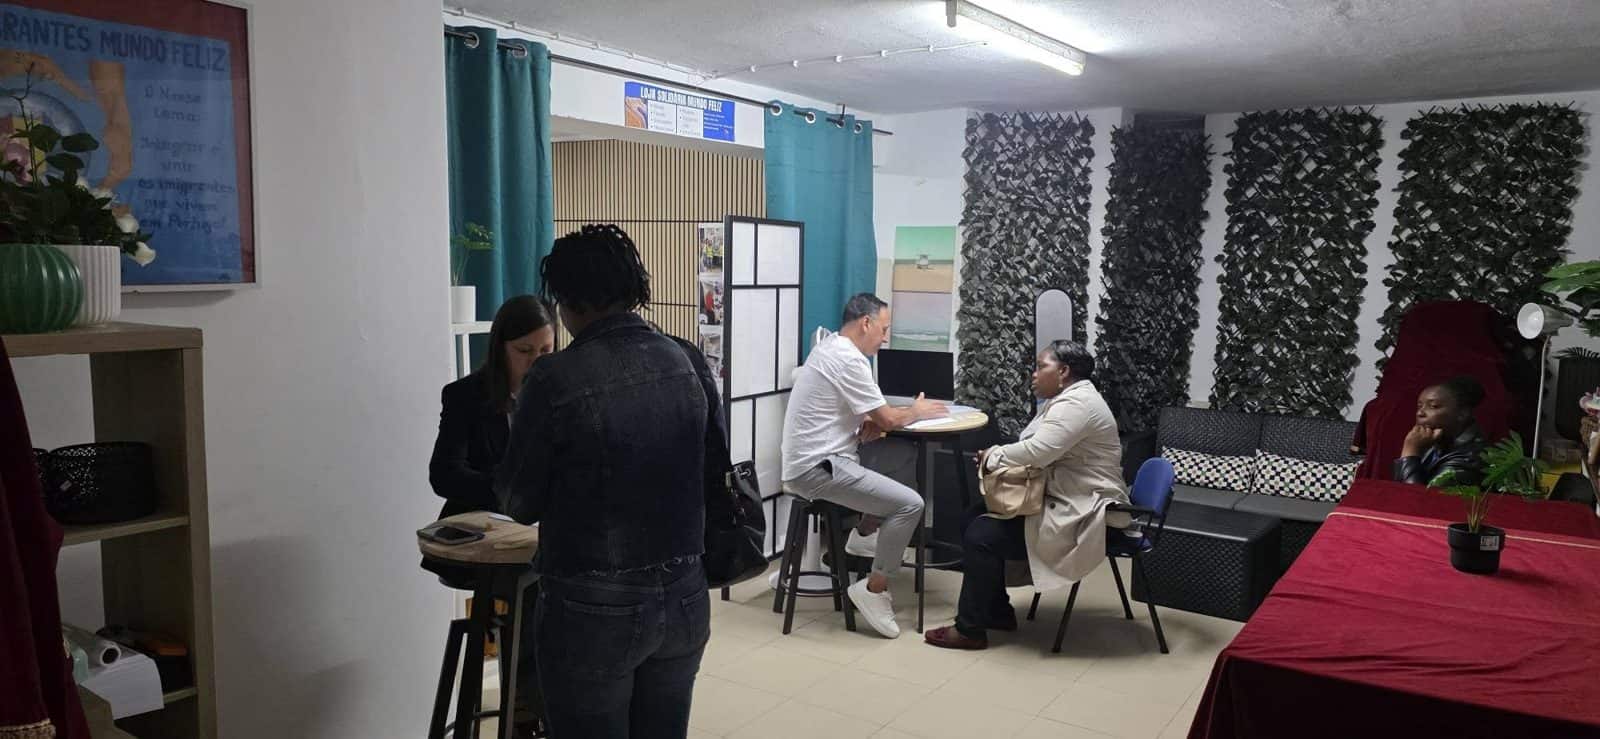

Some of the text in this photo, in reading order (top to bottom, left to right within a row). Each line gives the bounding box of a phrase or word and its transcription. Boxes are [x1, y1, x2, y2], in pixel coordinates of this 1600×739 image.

[0, 11, 226, 72] RANTES MUNDO FELIZ
[641, 86, 656, 100] LOJA
[708, 98, 723, 112] FELIZ
